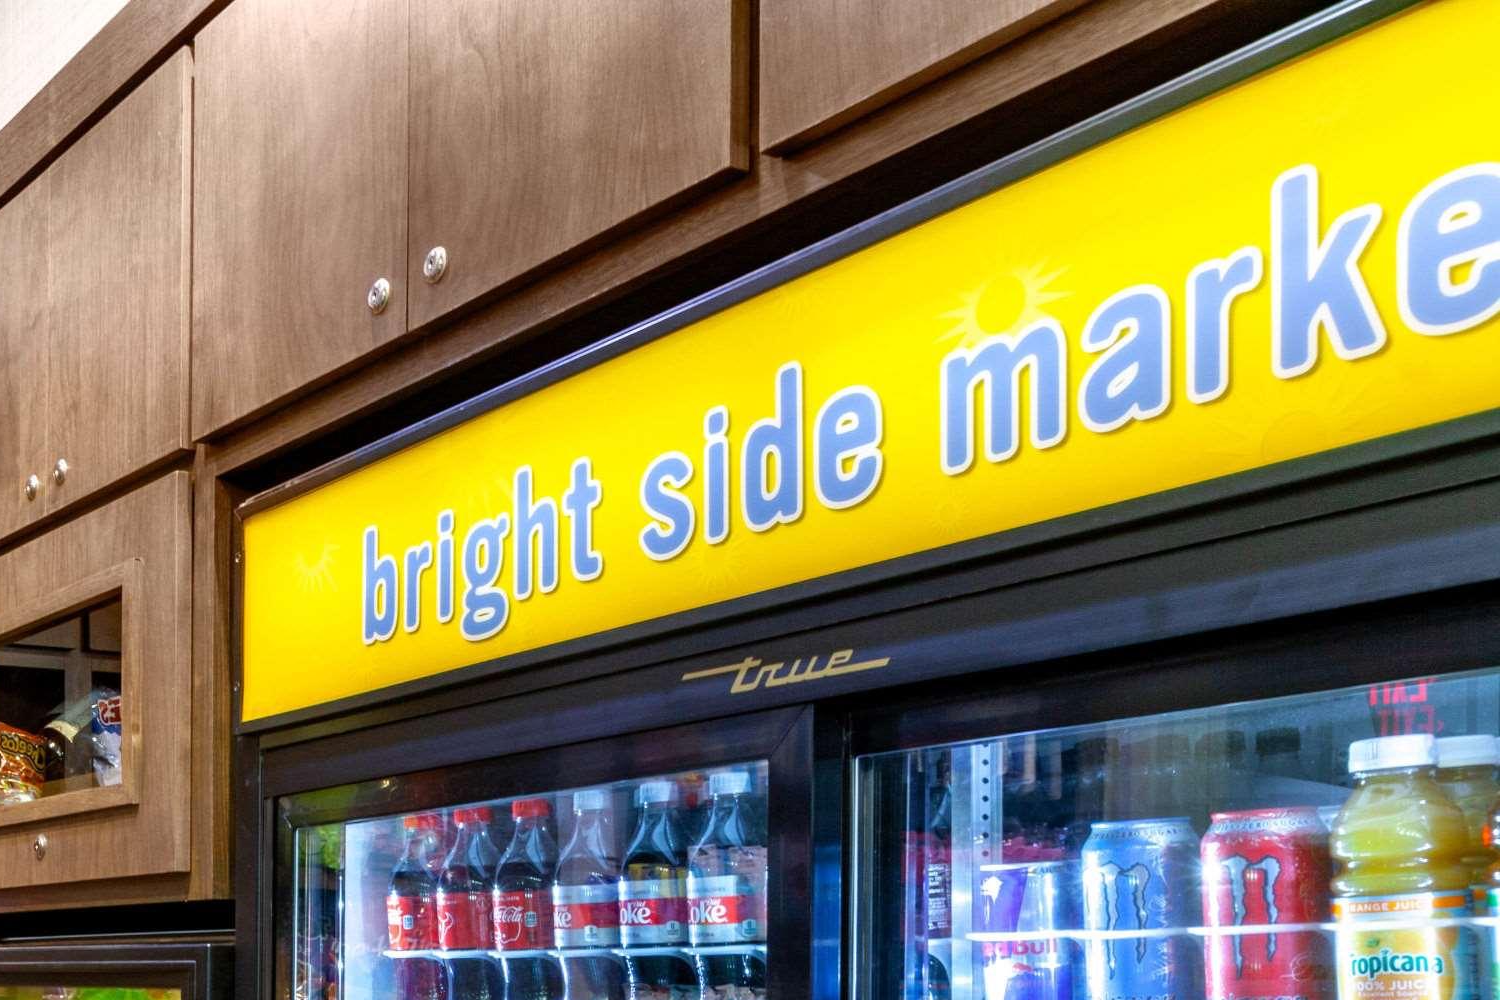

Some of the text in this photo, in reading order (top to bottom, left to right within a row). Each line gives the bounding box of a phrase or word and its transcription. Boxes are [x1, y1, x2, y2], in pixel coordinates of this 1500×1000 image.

[360, 165, 1500, 642] bright side marke
[680, 648, 890, 693] true
[619, 905, 652, 924] oke
[689, 903, 728, 924] oke
[1349, 900, 1389, 913] RANGE
[1351, 949, 1444, 979] ropicana
